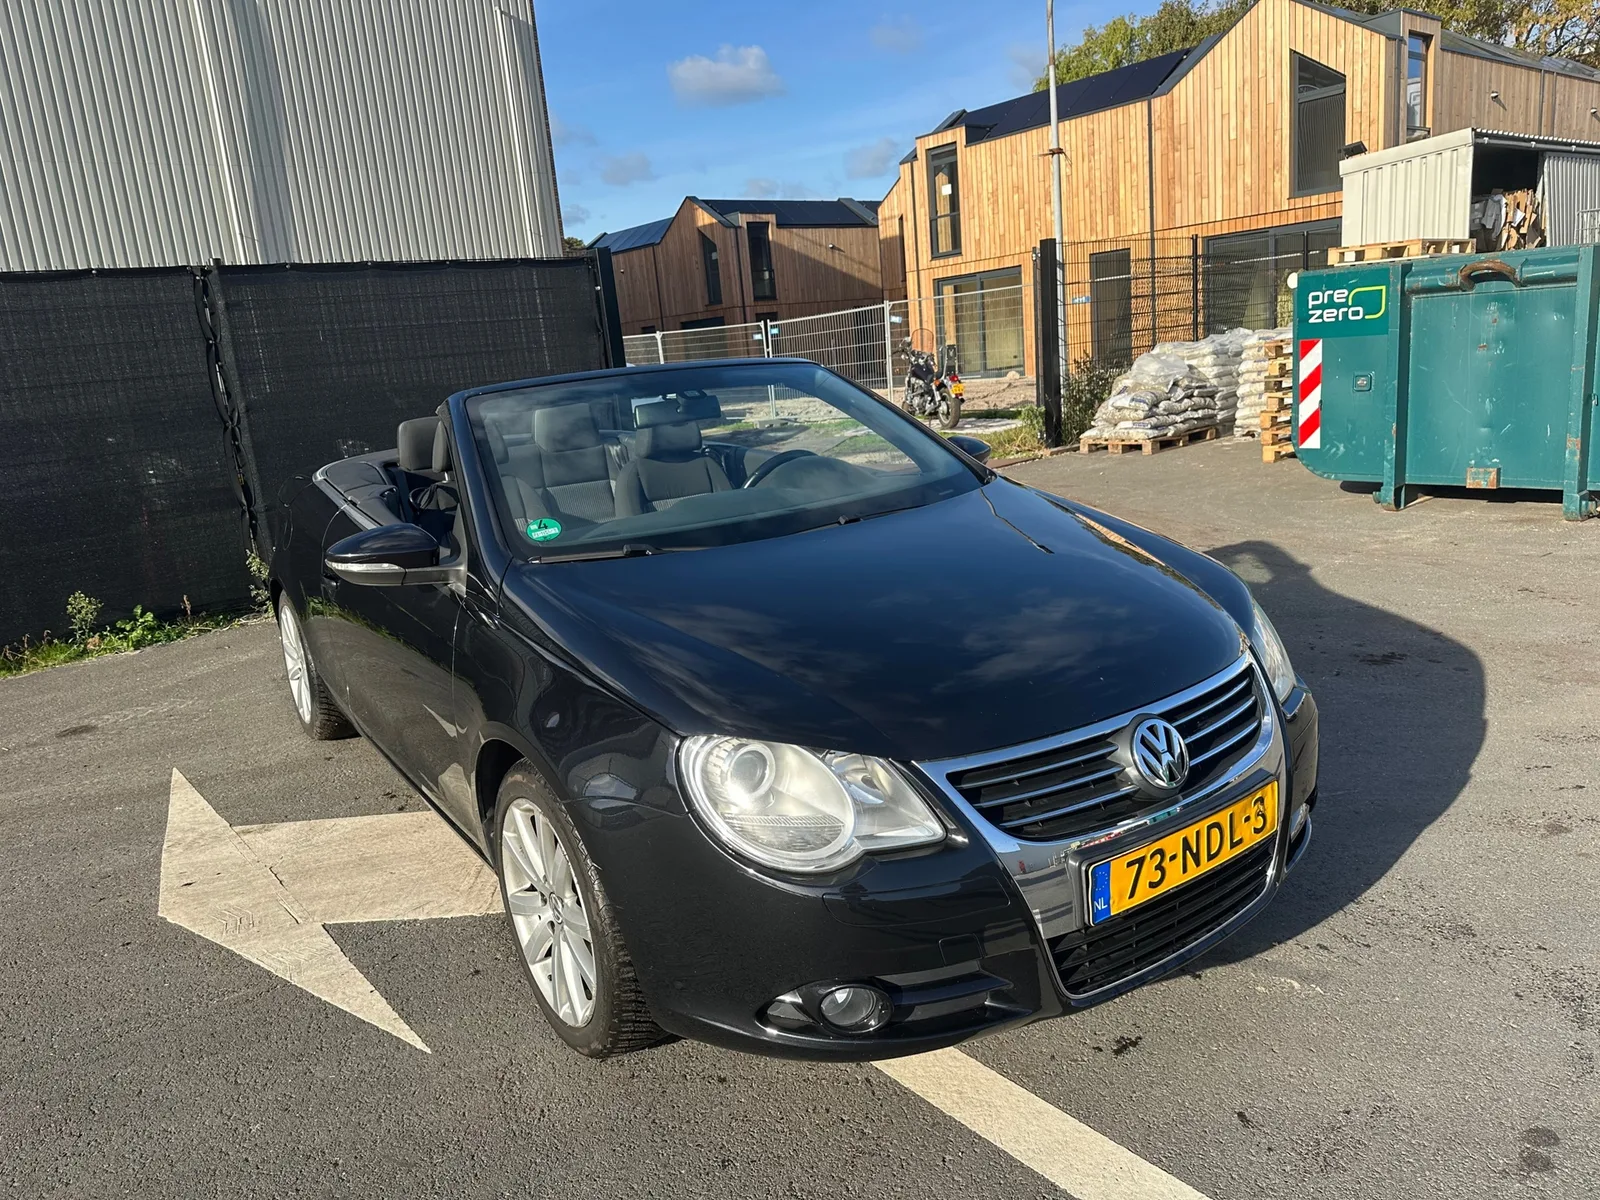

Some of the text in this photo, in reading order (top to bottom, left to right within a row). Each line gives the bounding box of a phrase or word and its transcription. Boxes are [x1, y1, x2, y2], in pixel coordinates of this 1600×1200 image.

[1308, 288, 1349, 309] pre
[1308, 306, 1363, 323] zero
[538, 519, 548, 529] 4
[1125, 796, 1268, 900] 73-NDL-3
[1094, 897, 1108, 913] NL
